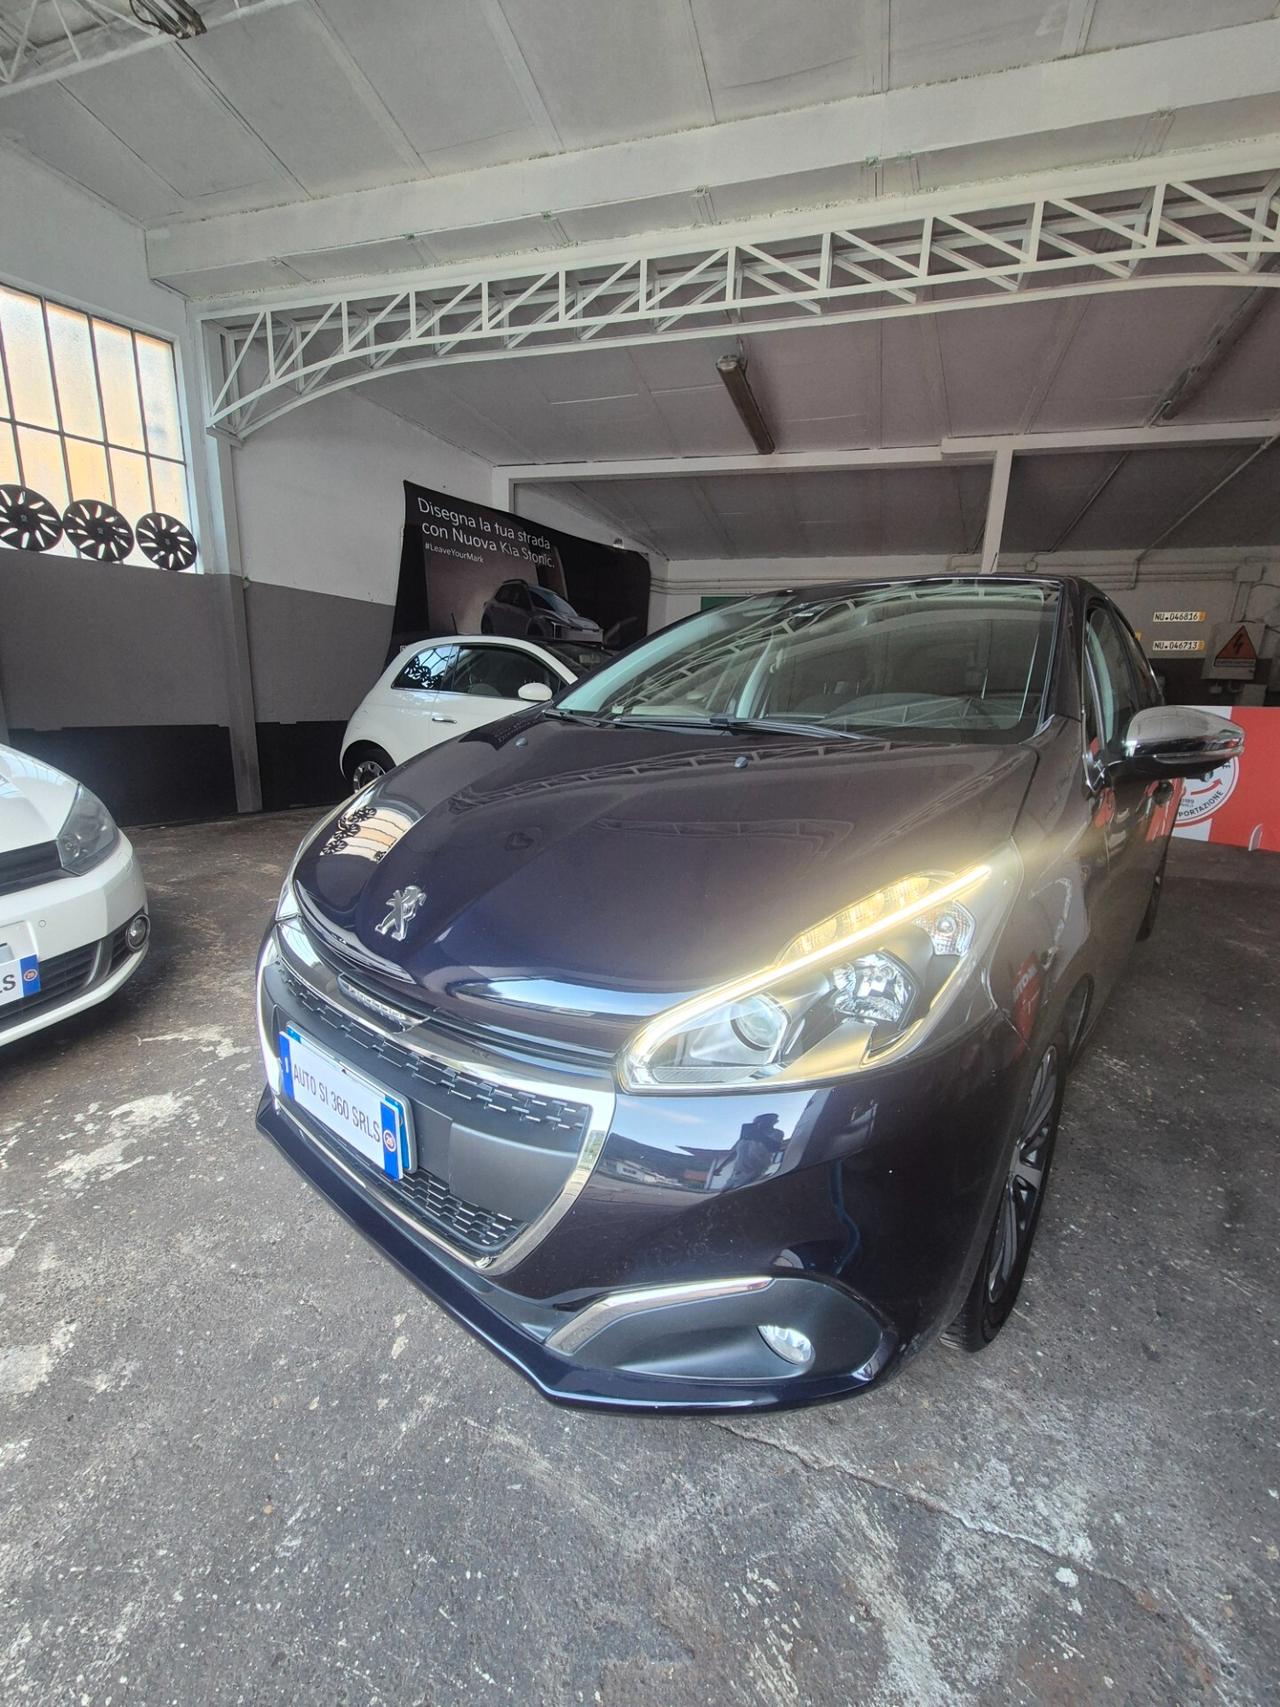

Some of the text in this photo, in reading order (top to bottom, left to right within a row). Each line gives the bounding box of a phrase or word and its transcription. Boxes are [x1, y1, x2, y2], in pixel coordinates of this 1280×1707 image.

[417, 497, 550, 550] Disegna la tua strada
[422, 522, 555, 569] con Nuova Kia Stonic.
[425, 542, 484, 563] #LeaveYourMark
[293, 1064, 381, 1143] AUTO SI 360 SRLS
